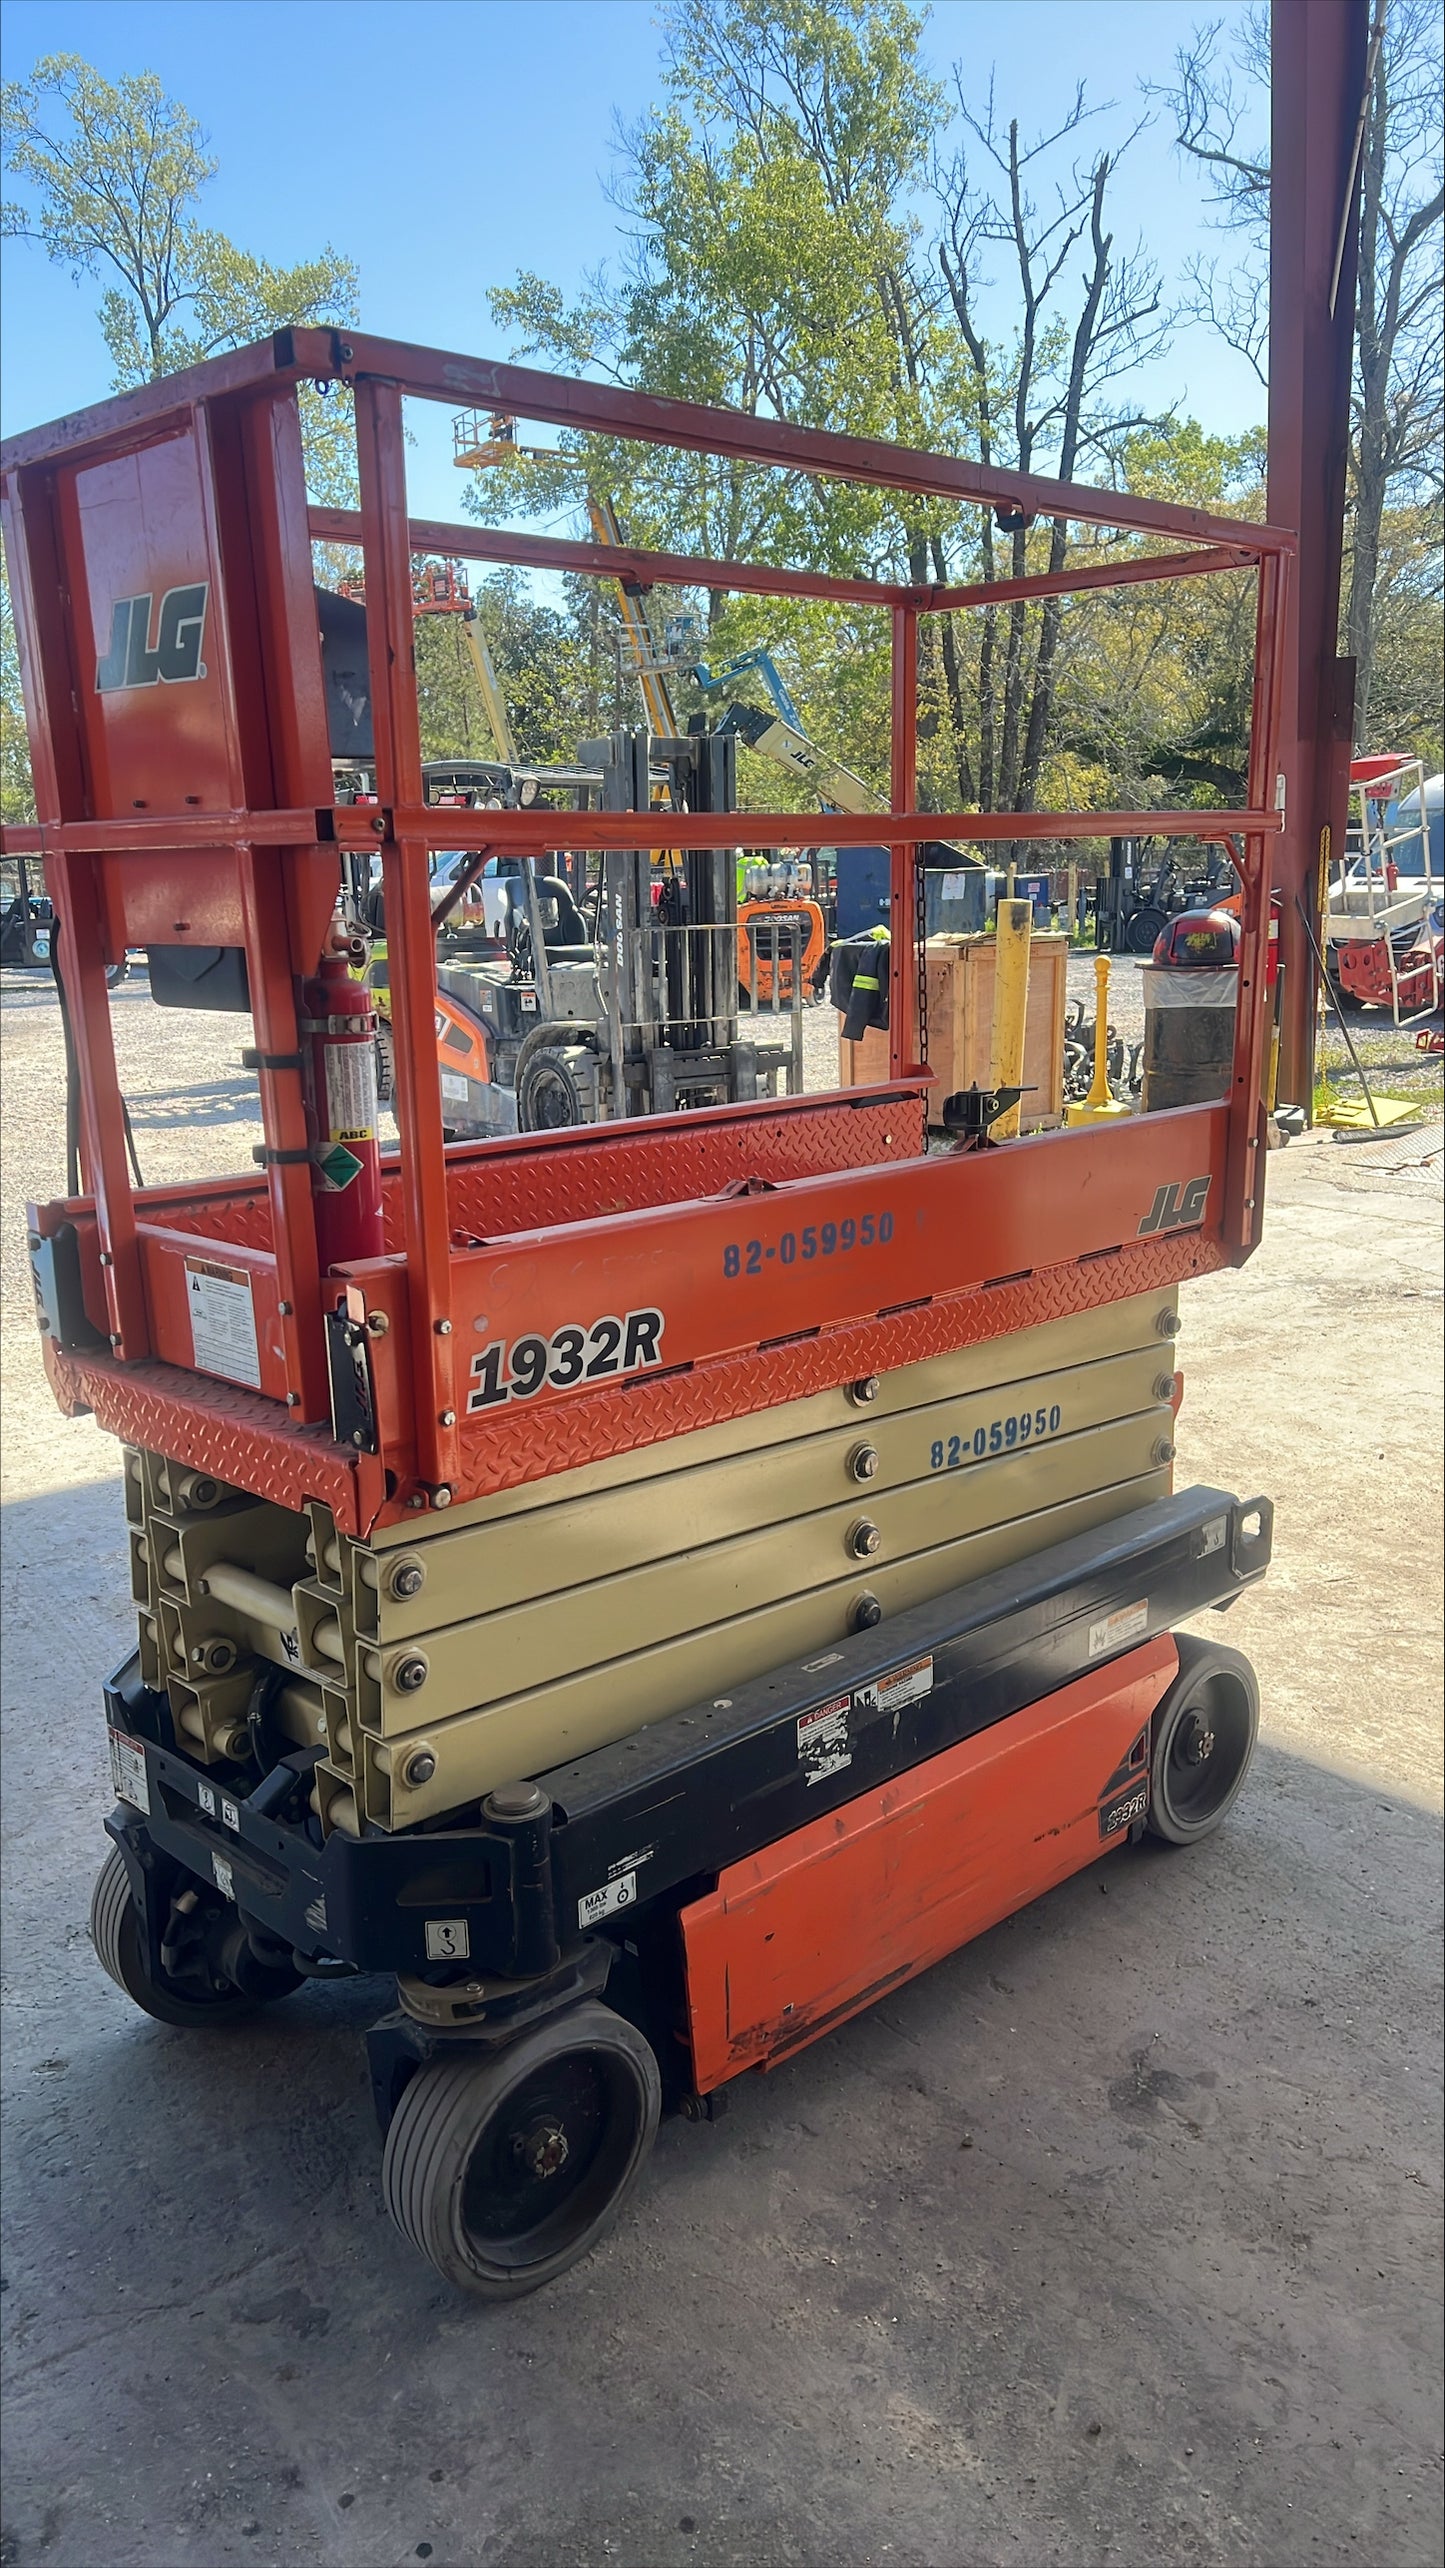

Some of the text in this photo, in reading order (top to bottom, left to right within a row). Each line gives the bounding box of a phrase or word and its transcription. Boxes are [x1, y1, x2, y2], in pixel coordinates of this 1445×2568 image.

[95, 581, 209, 694] JLG
[615, 893, 624, 968] DOOSAN
[338, 1129, 368, 1141] ABC
[1137, 1174, 1212, 1236] JLG
[723, 1210, 894, 1279] 82-059950
[467, 1307, 665, 1413] 1932R
[930, 1404, 1061, 1470] 82-059950
[813, 1701, 843, 1719] DANGER
[585, 1889, 608, 1909] MAX
